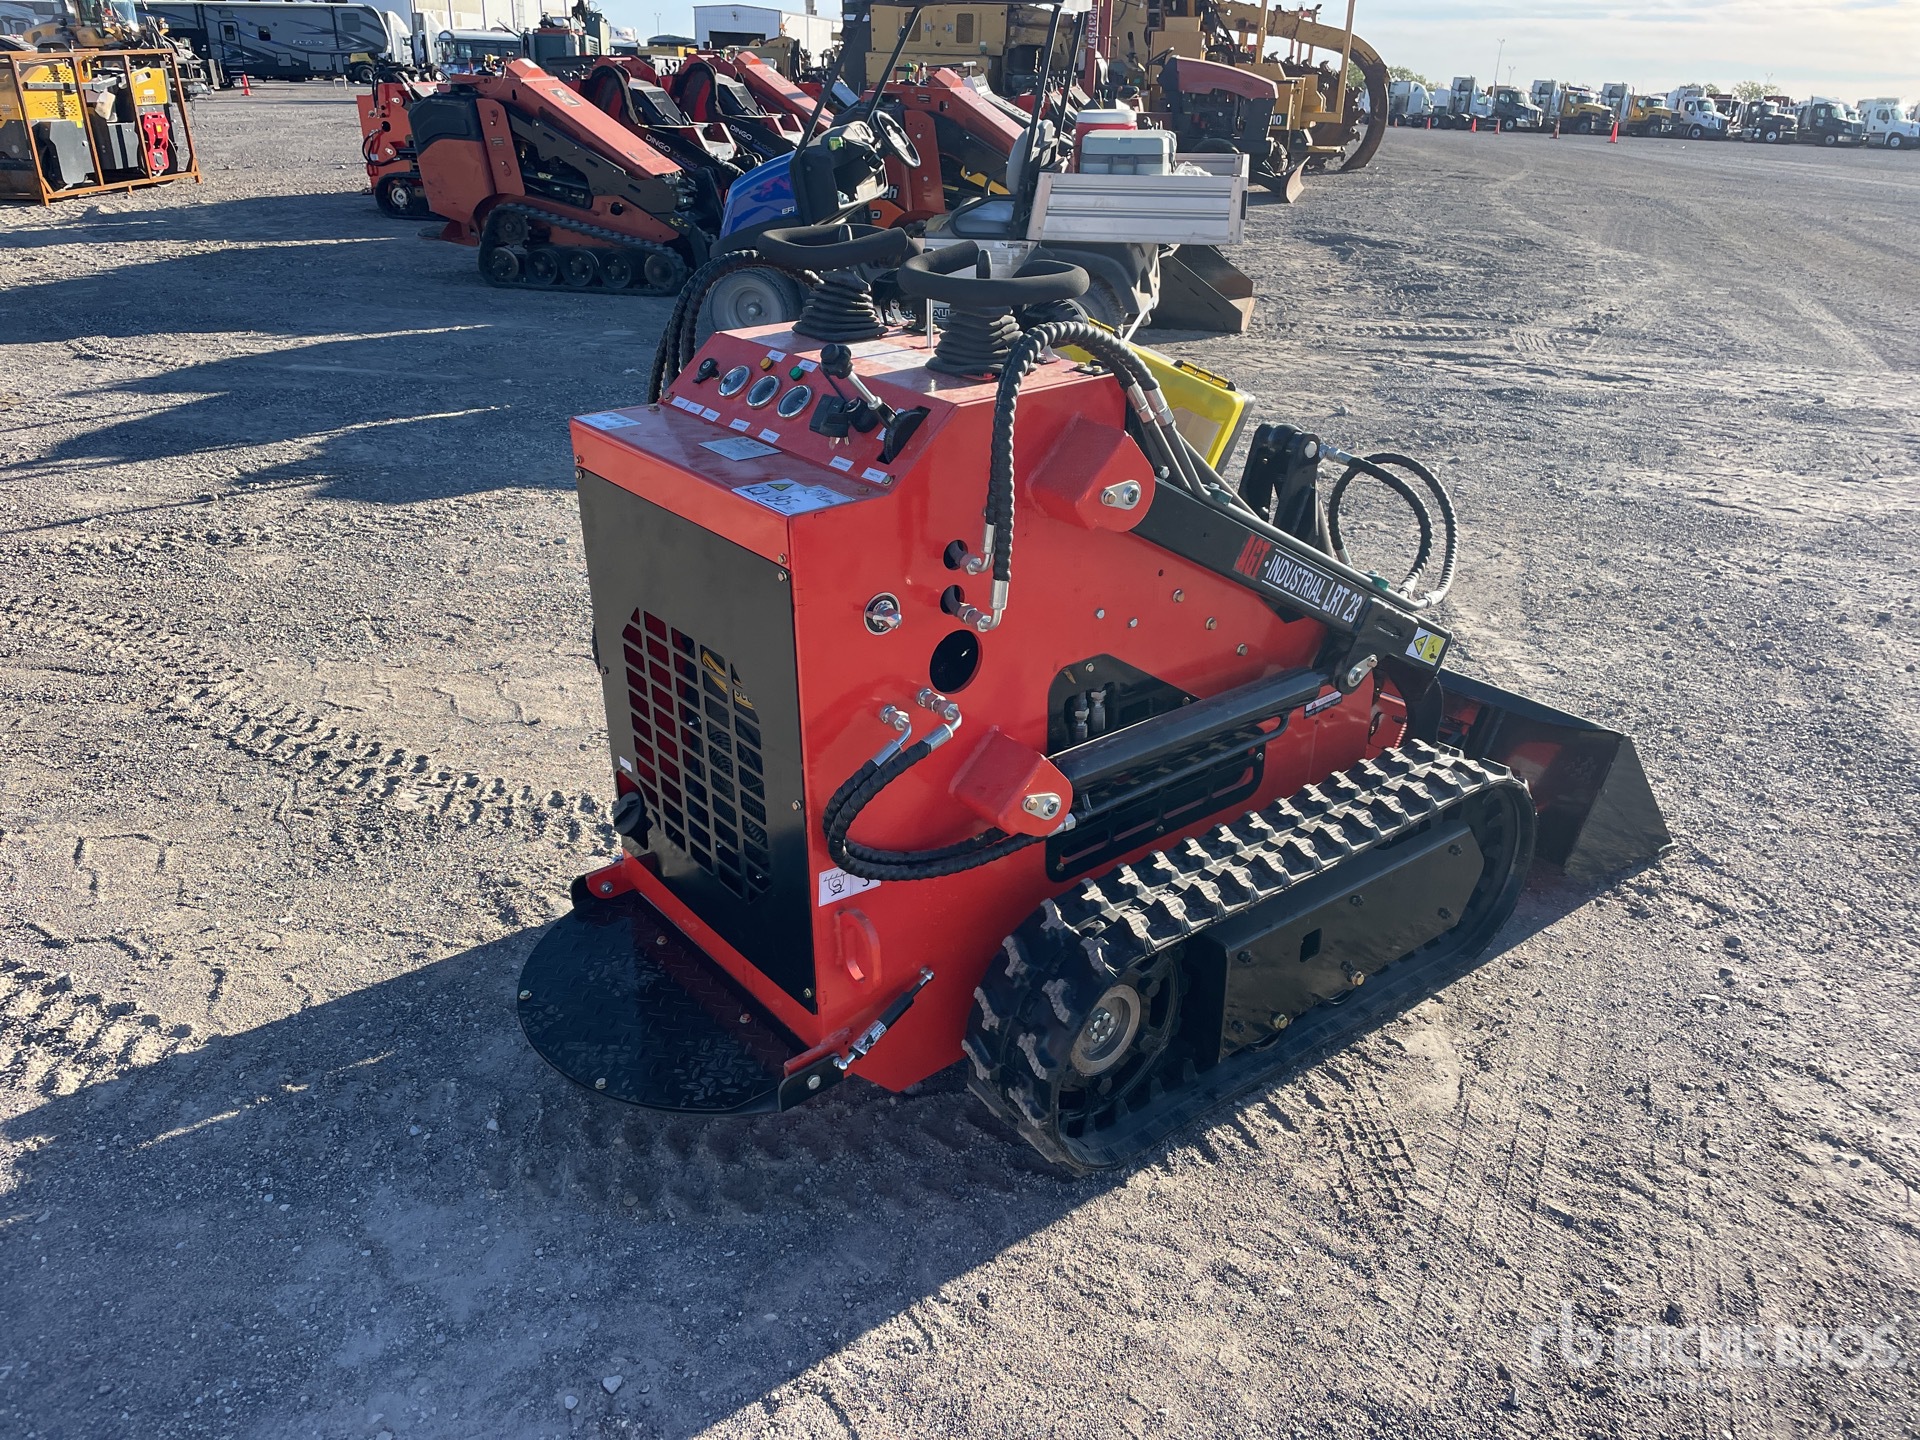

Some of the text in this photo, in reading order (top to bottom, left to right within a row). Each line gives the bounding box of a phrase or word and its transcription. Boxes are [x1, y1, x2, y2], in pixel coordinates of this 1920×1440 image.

[729, 124, 753, 141] DINGO
[645, 134, 671, 153] DINGO
[781, 206, 795, 215] EFI
[1234, 534, 1363, 623] AGT INDUSTRIAL LRT 23
